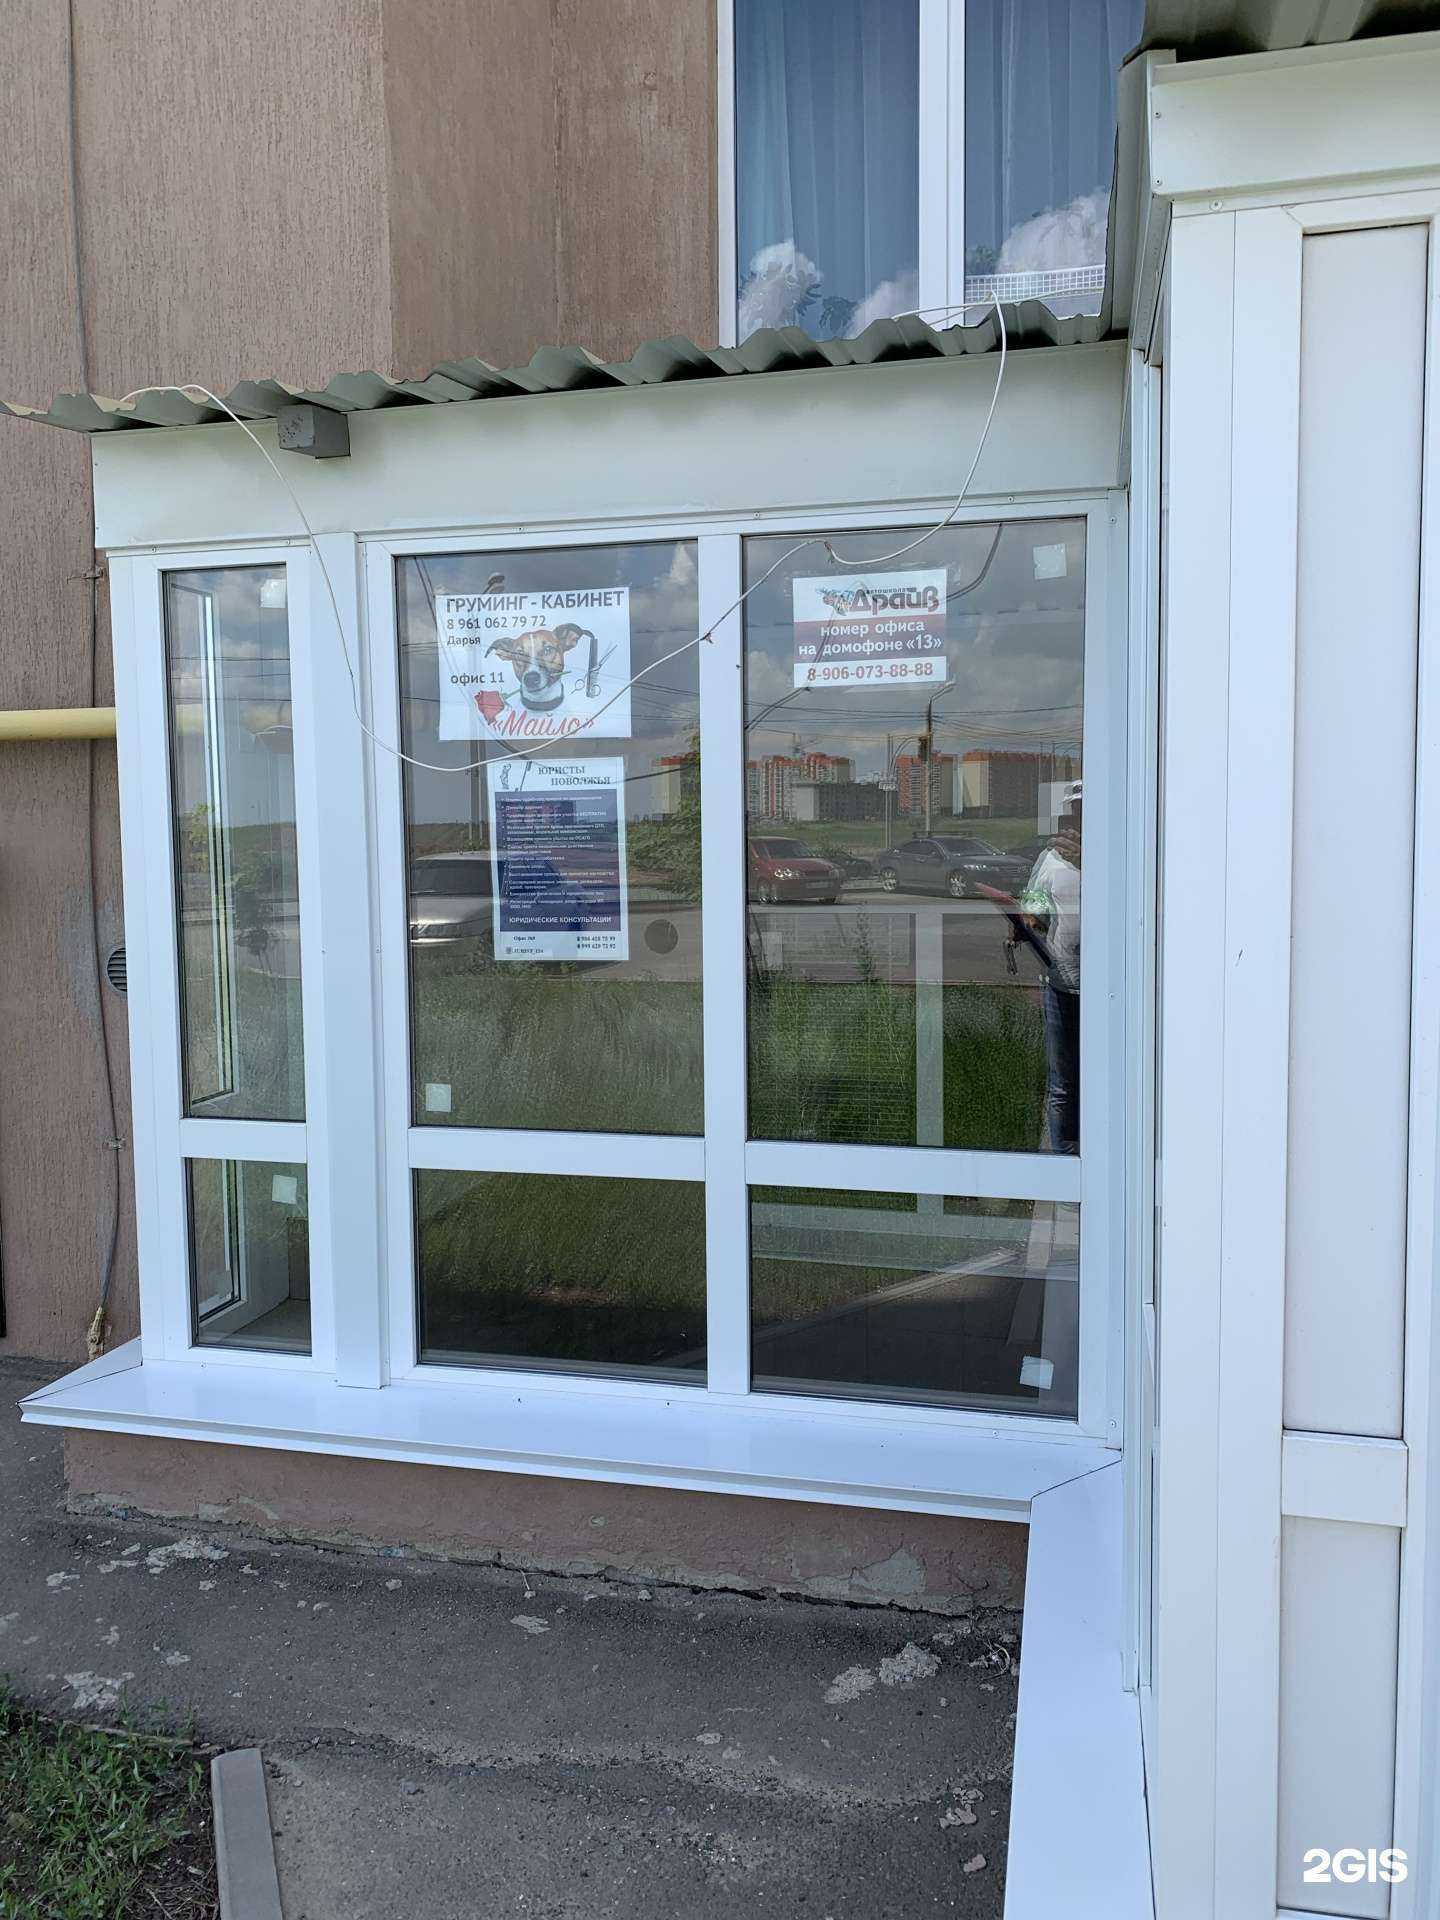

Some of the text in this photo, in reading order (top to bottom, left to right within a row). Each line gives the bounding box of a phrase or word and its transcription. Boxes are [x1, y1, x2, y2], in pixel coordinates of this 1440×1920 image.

[446, 595, 529, 613] ГРУМИНГ
[541, 590, 624, 609] КАБИНЕТ
[849, 586, 940, 615] Драйв
[447, 615, 547, 630] 8 961 062 79 72
[821, 620, 926, 637] номер офиса
[447, 635, 481, 647] Дарья
[798, 634, 942, 657] на домофоне «13»
[450, 672, 505, 687] офис 11
[807, 662, 934, 682] 8-906-073-88-88
[491, 709, 595, 737] «Майло»
[538, 766, 585, 775] ЮРИСТЫ
[509, 916, 559, 924] ЮРИДИЧЕСКИЕ
